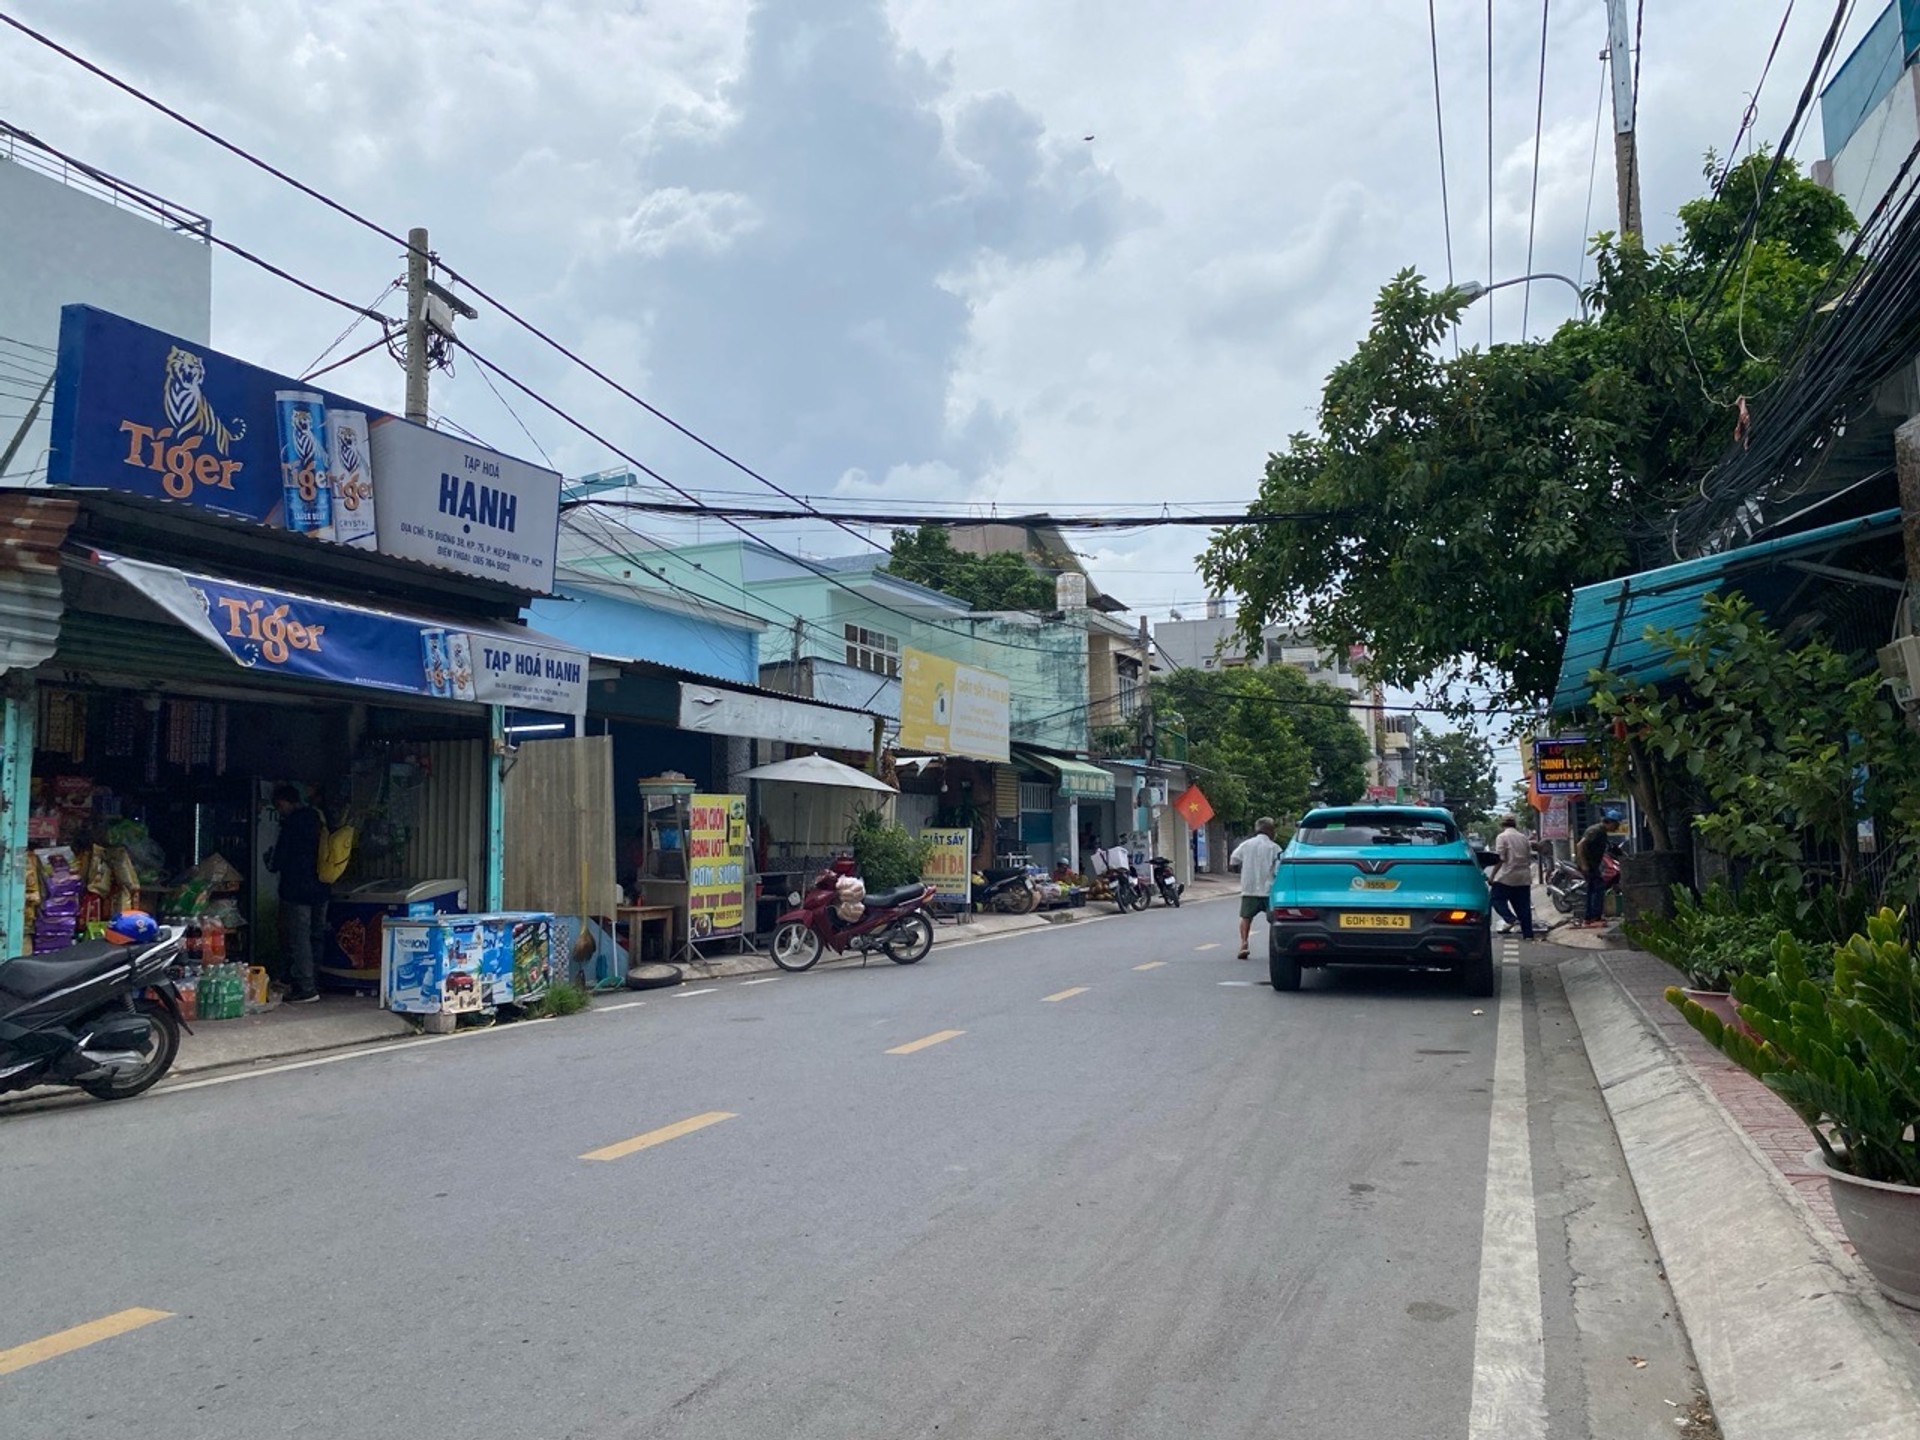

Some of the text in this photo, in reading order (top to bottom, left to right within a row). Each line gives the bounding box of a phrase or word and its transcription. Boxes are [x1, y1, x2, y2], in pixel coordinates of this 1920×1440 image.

[119, 420, 243, 498] Tiger
[463, 454, 500, 480] TẠP HOÁ
[438, 472, 518, 534] HẠNH
[219, 596, 325, 664] Tiger
[483, 647, 581, 687] TẠP HOÁ HẠNH
[946, 830, 965, 846] SẤY
[411, 938, 428, 950] ION
[482, 938, 497, 949] ON
